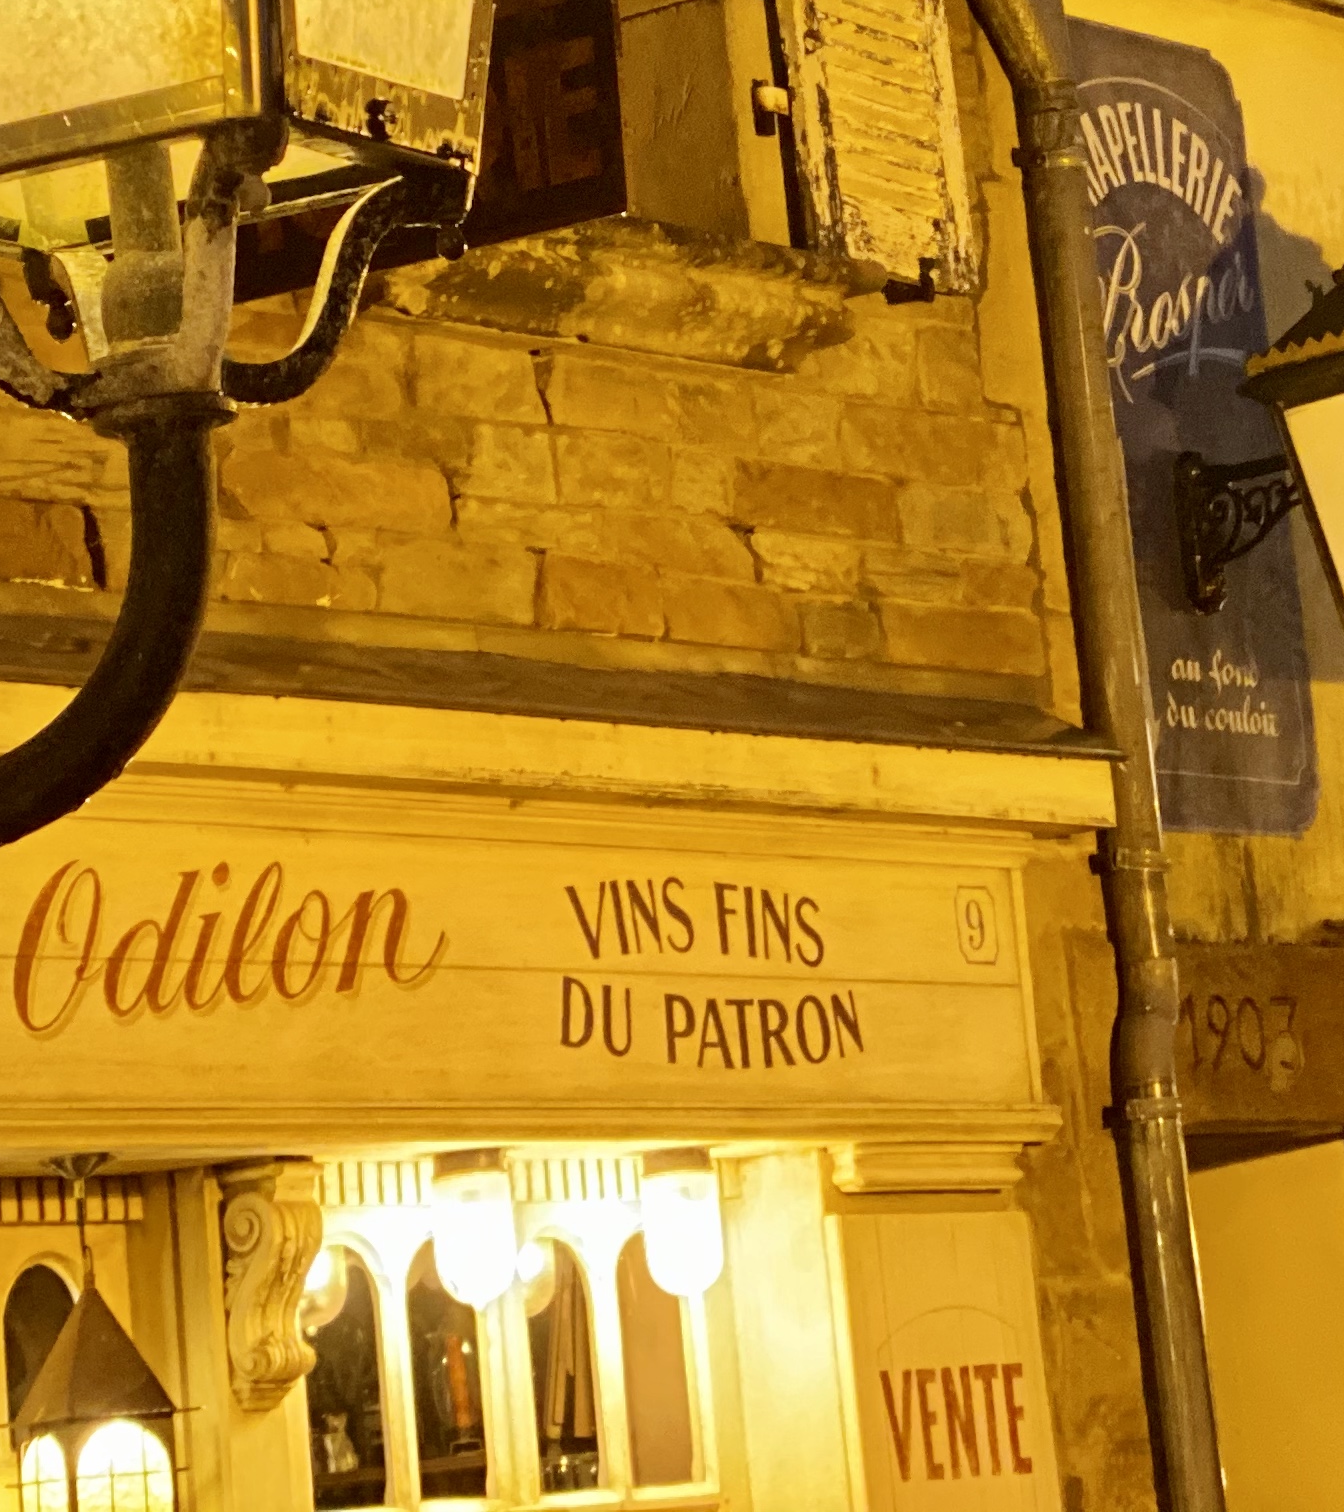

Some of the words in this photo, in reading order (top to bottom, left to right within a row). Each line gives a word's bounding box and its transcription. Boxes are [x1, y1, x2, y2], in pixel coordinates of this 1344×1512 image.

[1080, 101, 1242, 244] APELLERIE
[1167, 690, 1197, 729] du
[1205, 694, 1280, 738] couloir
[13, 859, 446, 1032] Odilon
[565, 877, 695, 959] VINS
[713, 881, 824, 967] FINS
[965, 899, 986, 951] 9
[560, 976, 633, 1056] DU
[664, 990, 864, 1069] PATRON
[879, 1362, 1033, 1483] VENTE
